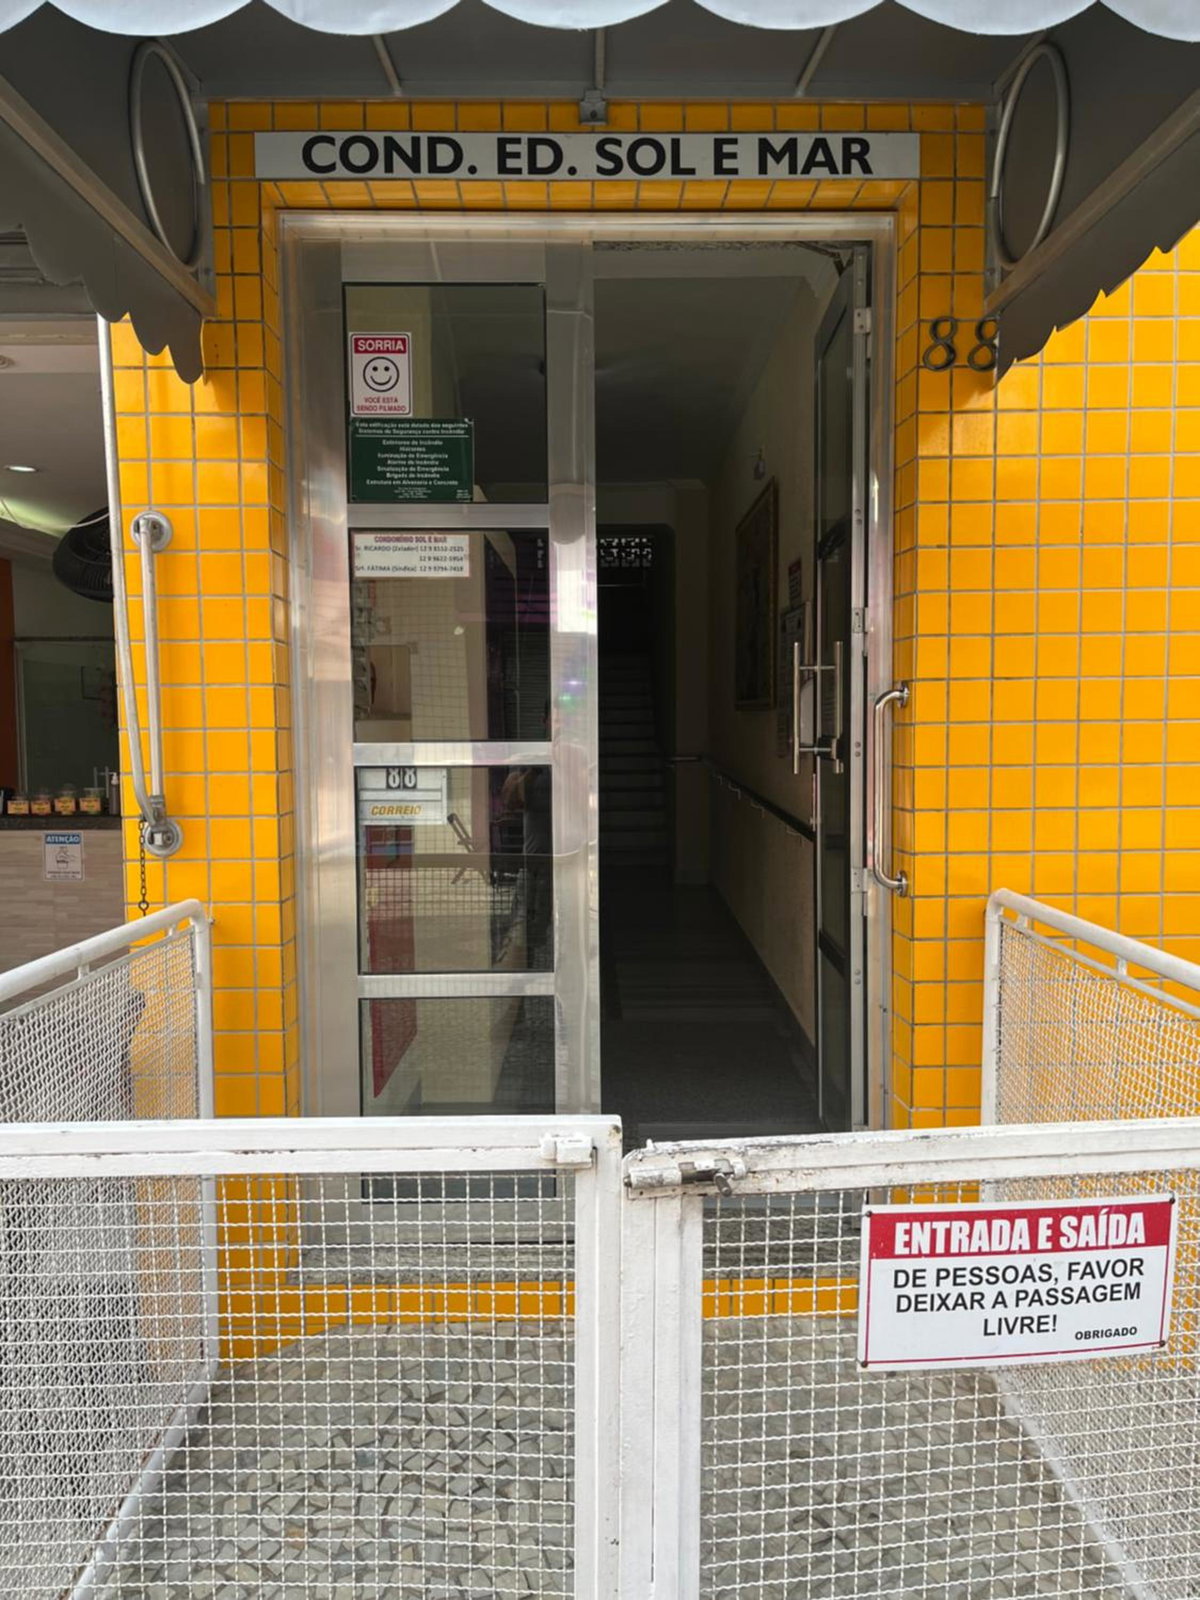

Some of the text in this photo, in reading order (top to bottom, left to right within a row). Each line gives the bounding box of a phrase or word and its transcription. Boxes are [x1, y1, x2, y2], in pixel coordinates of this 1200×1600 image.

[301, 135, 873, 176] COND. ED. SOL E MAR
[357, 339, 404, 351] SORRIA
[922, 316, 998, 372] 88
[371, 806, 421, 815] CORREIO
[894, 1209, 1146, 1255] ENTRADA E SAÍDA
[893, 1257, 1144, 1288] DE PESSOAS, FAVOR
[896, 1282, 1141, 1313] DEIXAR A PASSAGEM
[983, 1314, 1057, 1336] LIVRE!
[1075, 1326, 1138, 1340] OBRIGADO
